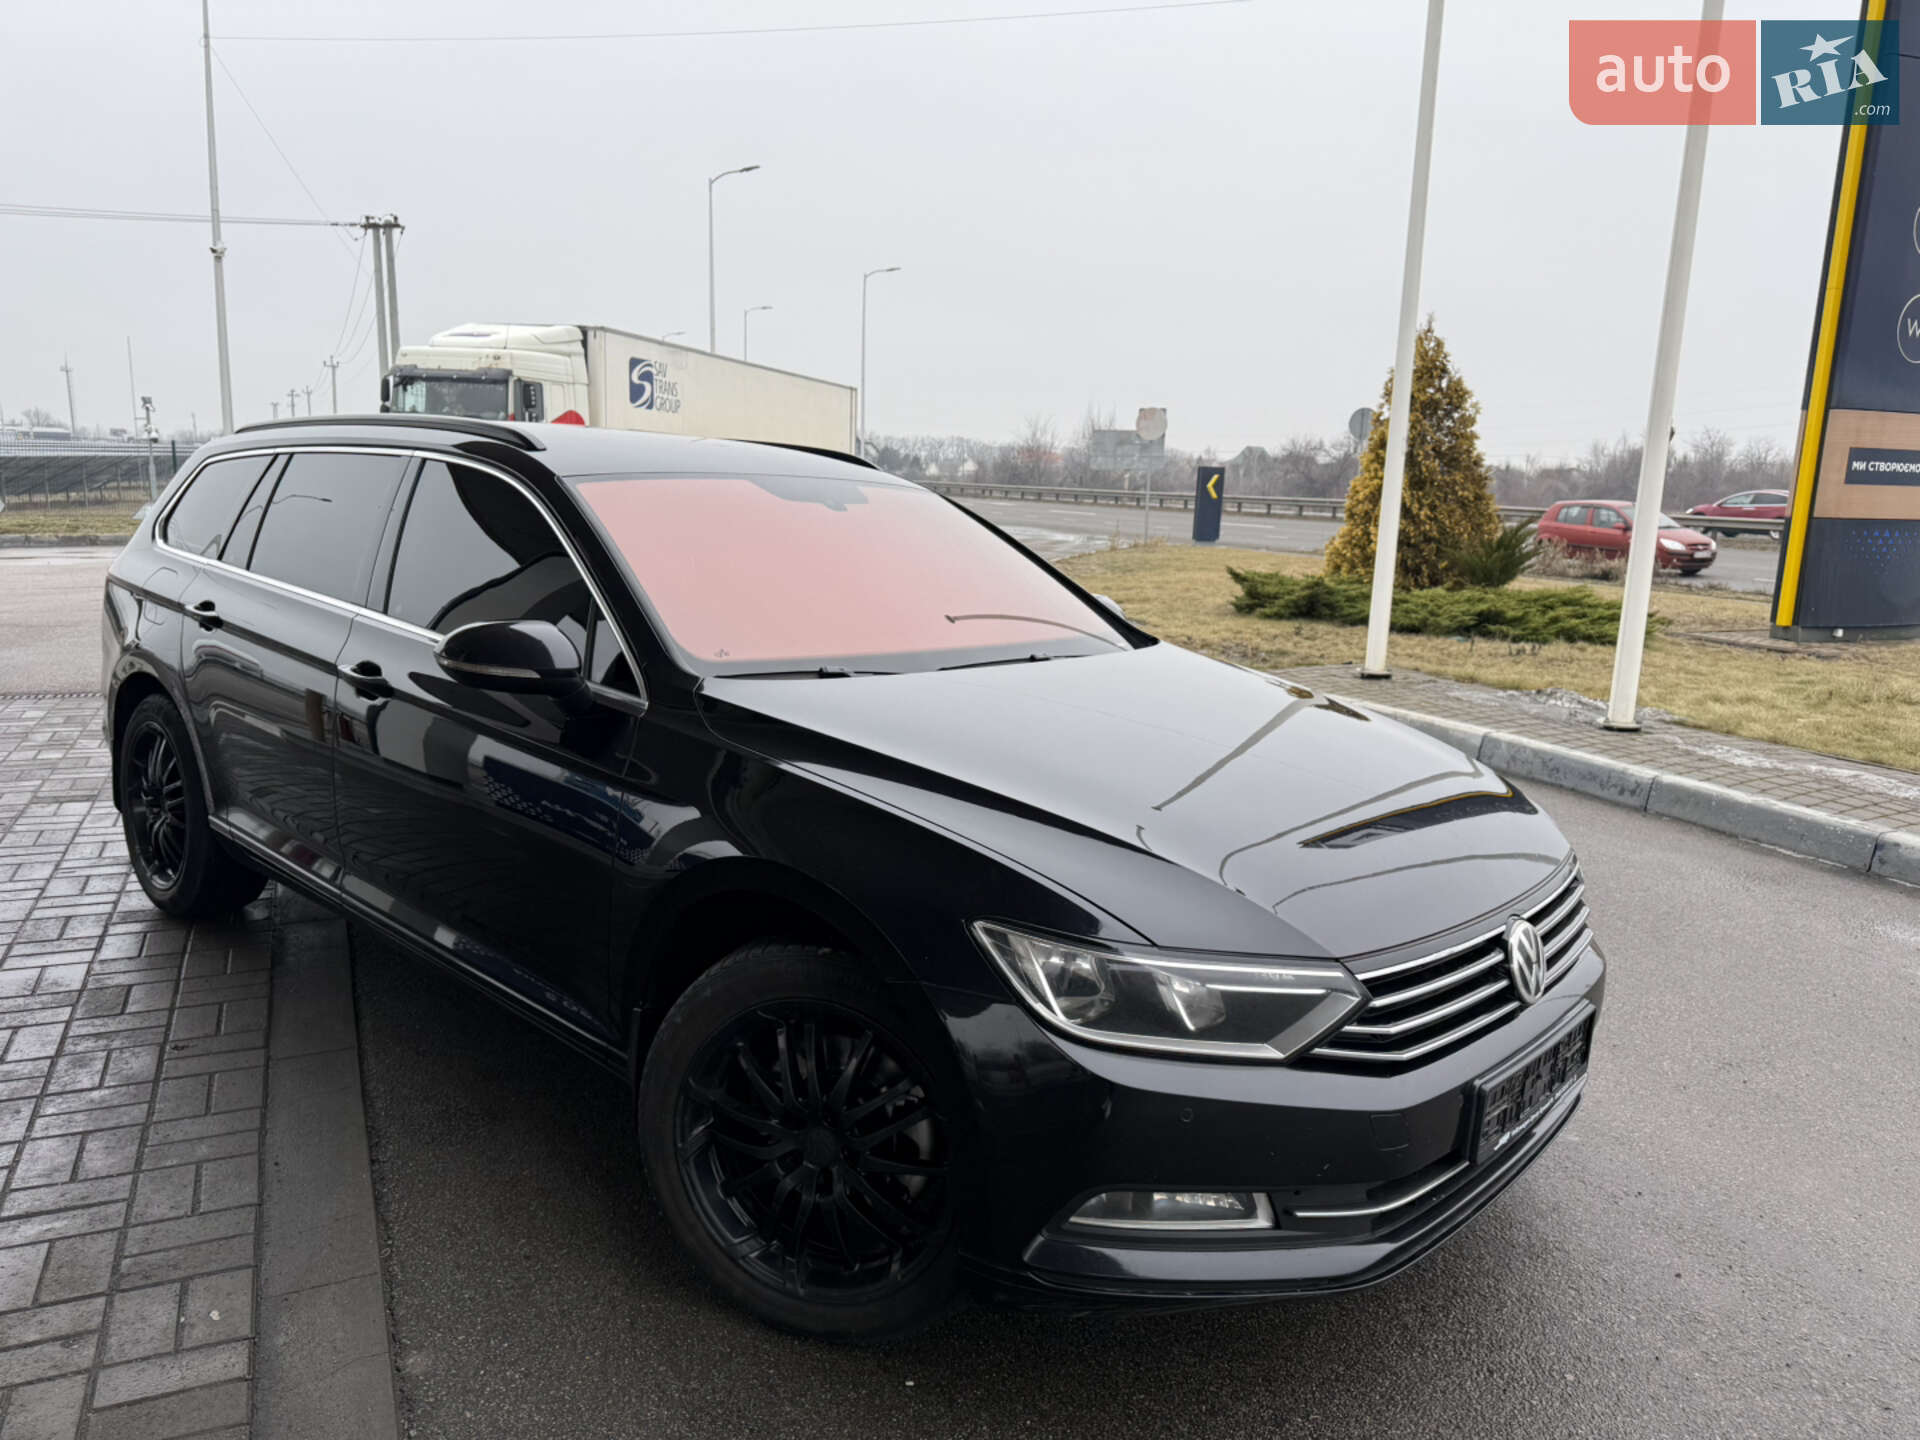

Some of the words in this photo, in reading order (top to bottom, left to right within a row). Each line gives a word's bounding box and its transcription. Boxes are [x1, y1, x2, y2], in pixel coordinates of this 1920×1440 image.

[654, 379, 678, 398] TRANS
[656, 395, 681, 414] GROUP
[1851, 460, 1866, 472] МИ
